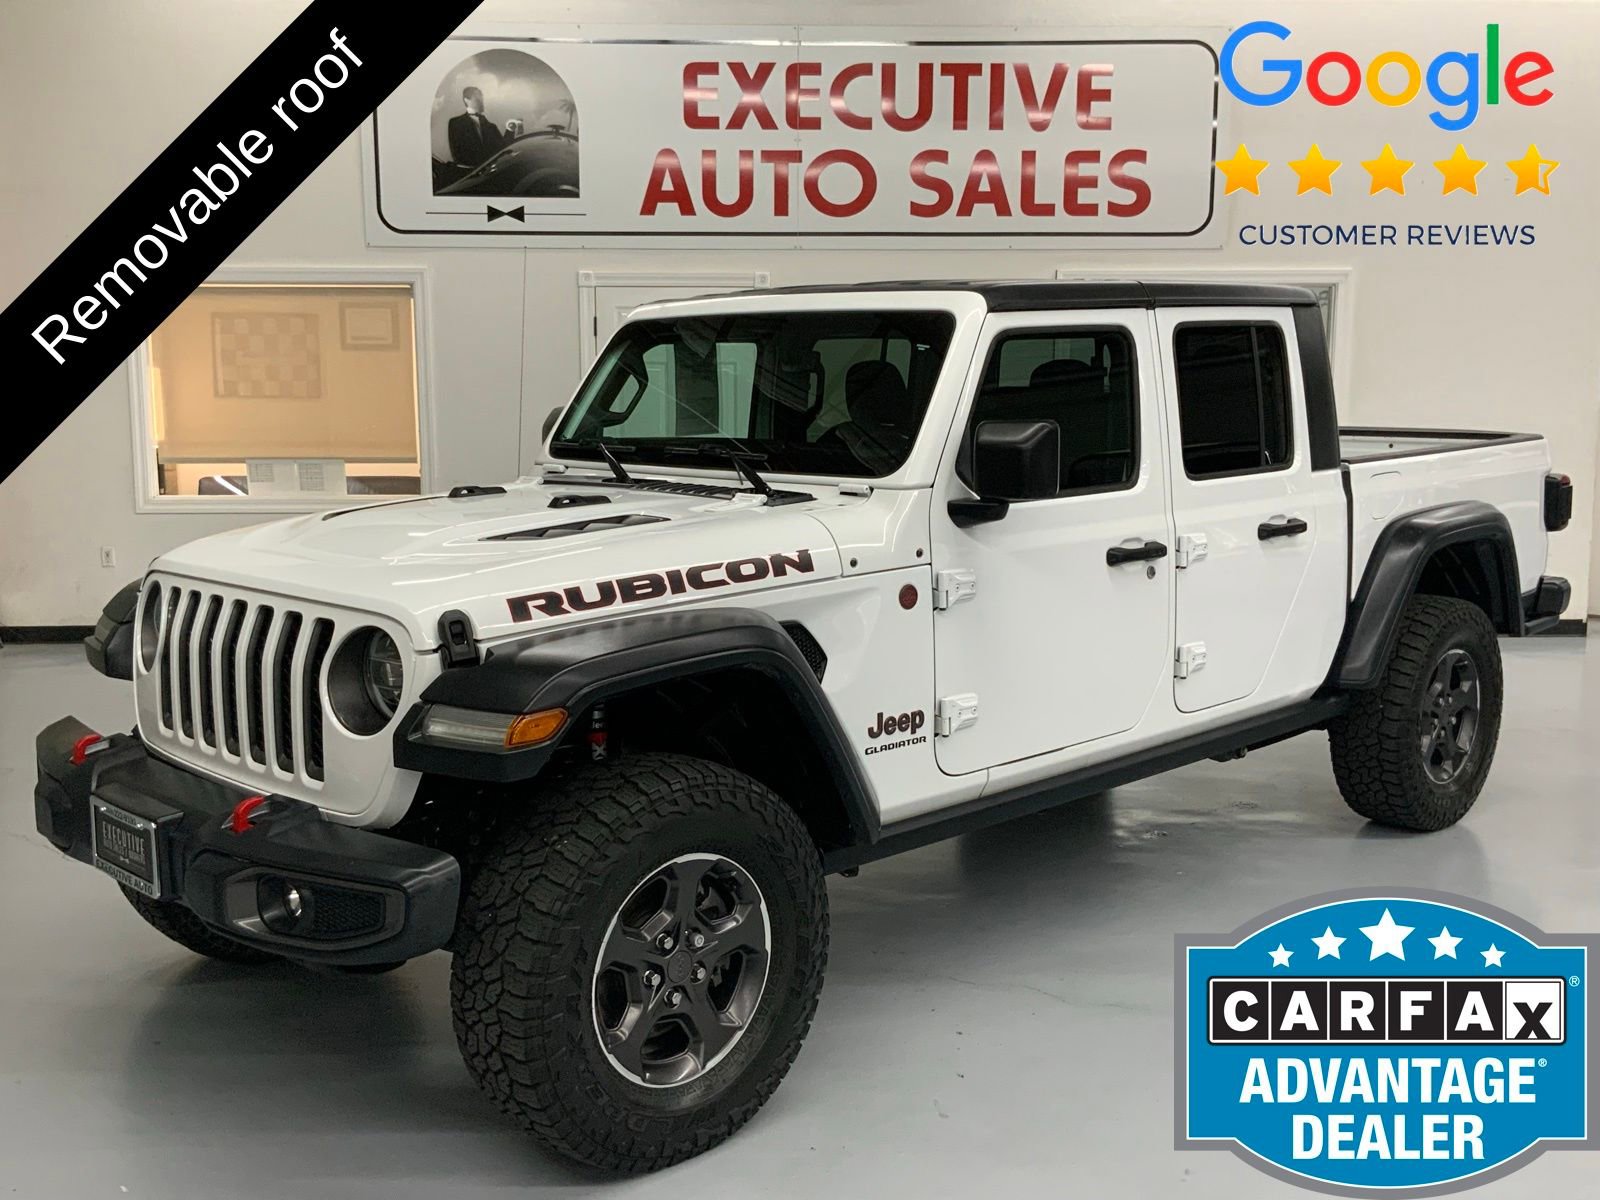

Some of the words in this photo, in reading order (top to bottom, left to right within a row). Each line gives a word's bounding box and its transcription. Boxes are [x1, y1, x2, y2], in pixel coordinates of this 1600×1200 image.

[682, 61, 1114, 132] EXECUTIVE
[640, 147, 877, 218] AUTO
[909, 148, 1152, 218] SALES
[506, 549, 815, 623] RUBICON
[864, 735, 927, 755] GLADIATOR
[867, 709, 925, 739] Jeep
[102, 820, 145, 856] EXECUTIVE
